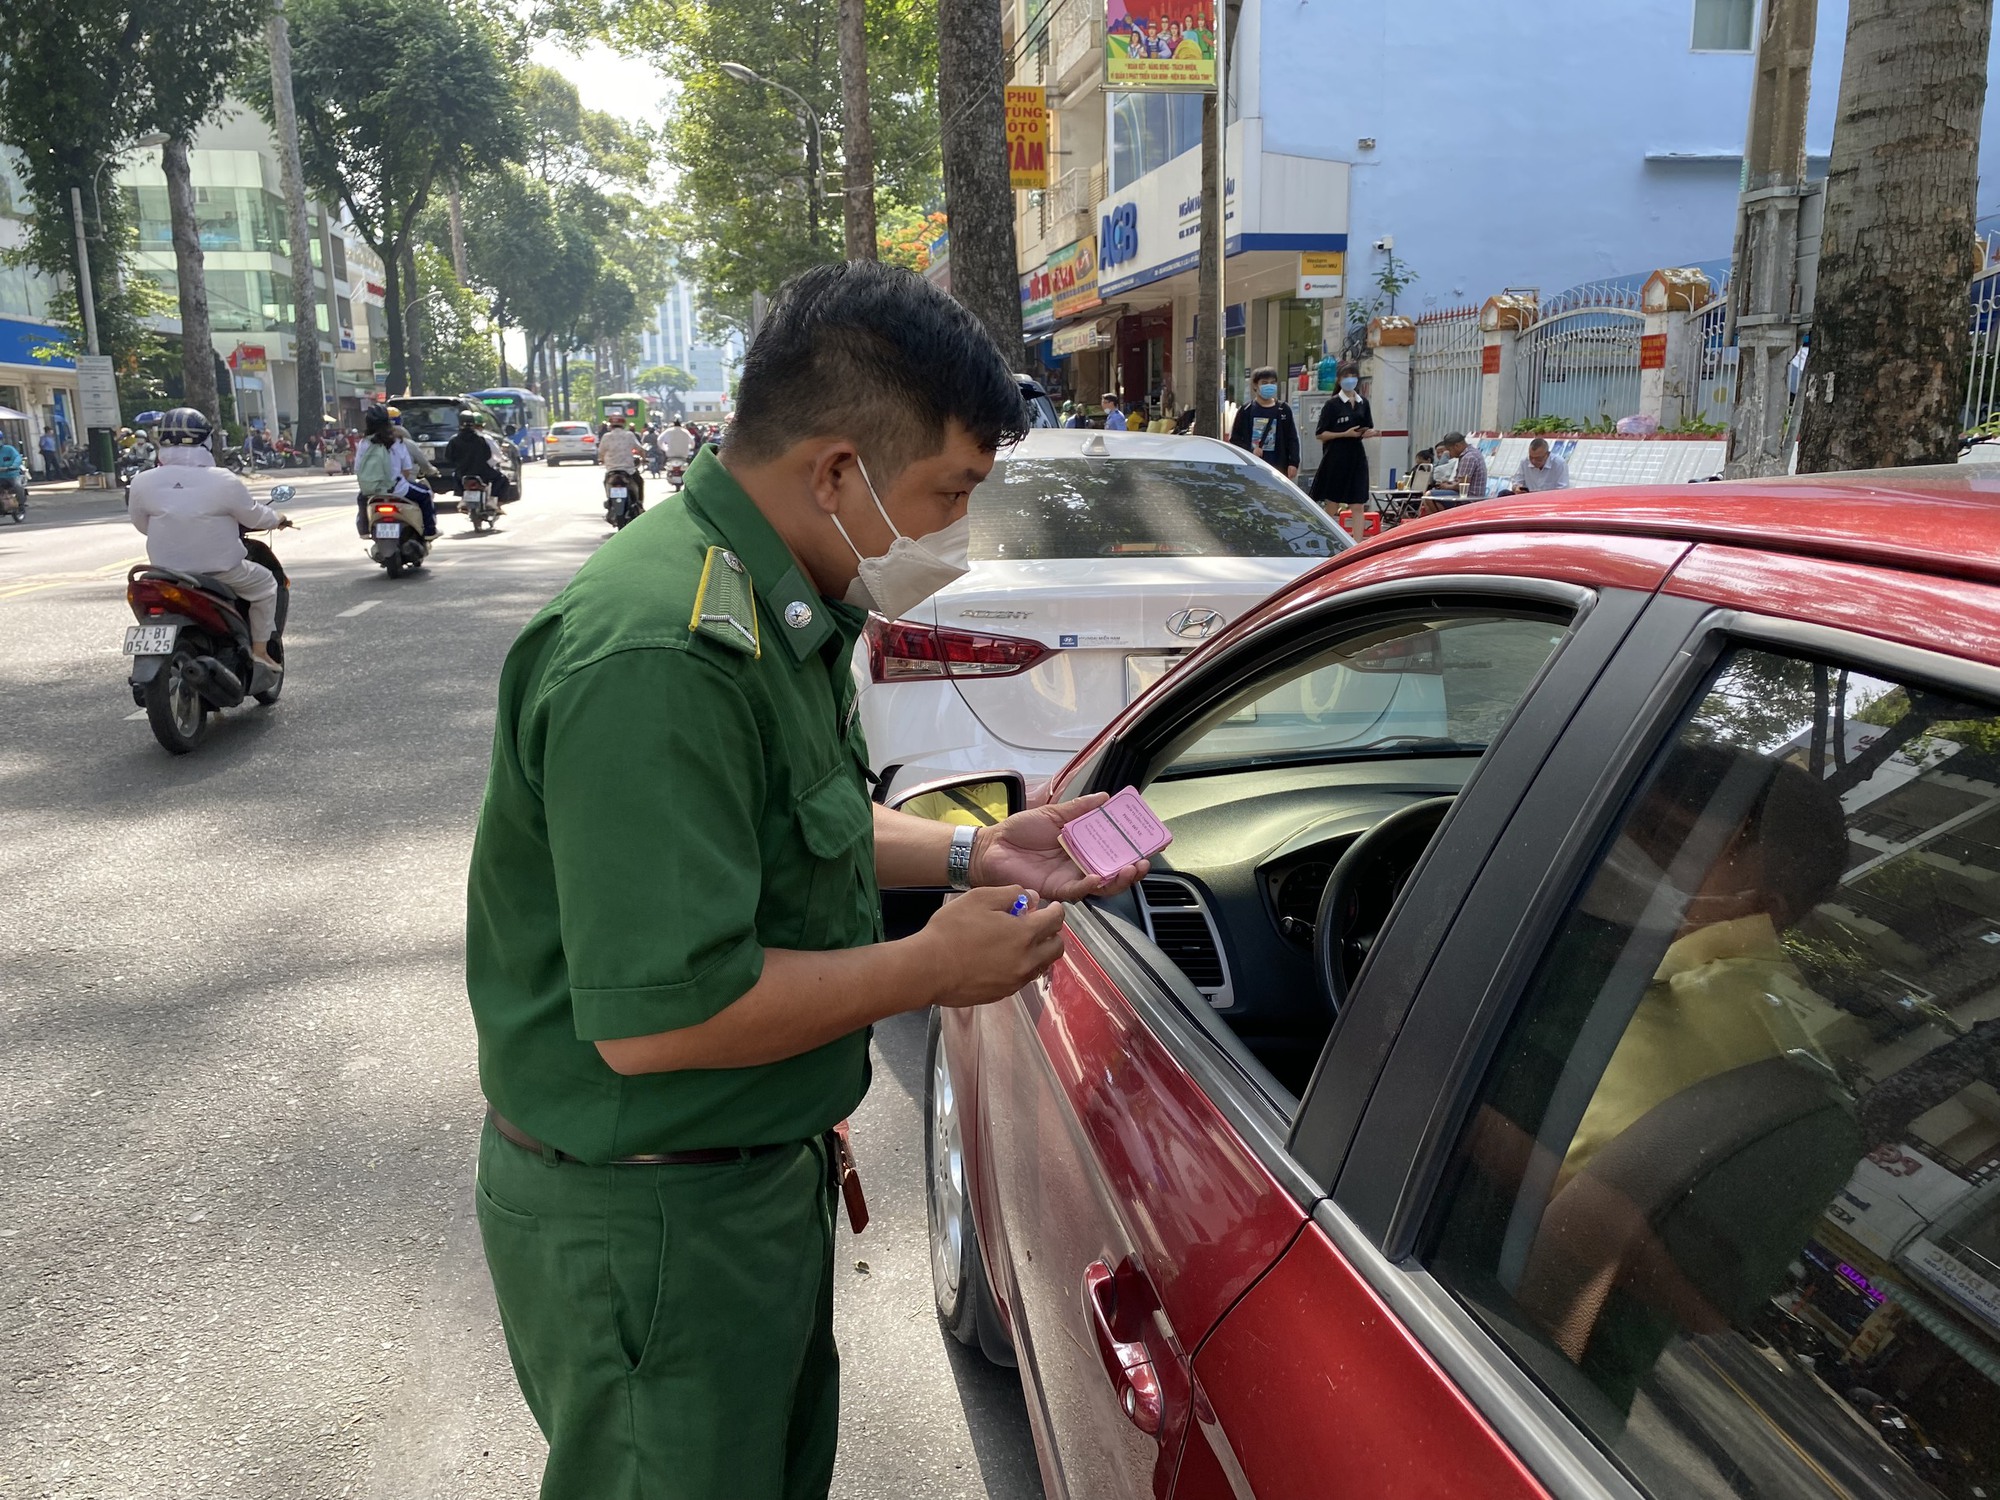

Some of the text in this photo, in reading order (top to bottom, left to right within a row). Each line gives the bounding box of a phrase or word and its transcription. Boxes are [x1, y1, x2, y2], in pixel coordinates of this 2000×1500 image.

[1007, 92, 1037, 106] PHỤ
[1005, 104, 1042, 118] TÙNG
[1008, 119, 1038, 133] ÔTÔ
[1007, 135, 1044, 171] TÂM
[1099, 202, 1138, 271] ACB
[959, 610, 1033, 620] ACCENT
[132, 627, 167, 640] 71-B1
[126, 640, 171, 653] 054.25
